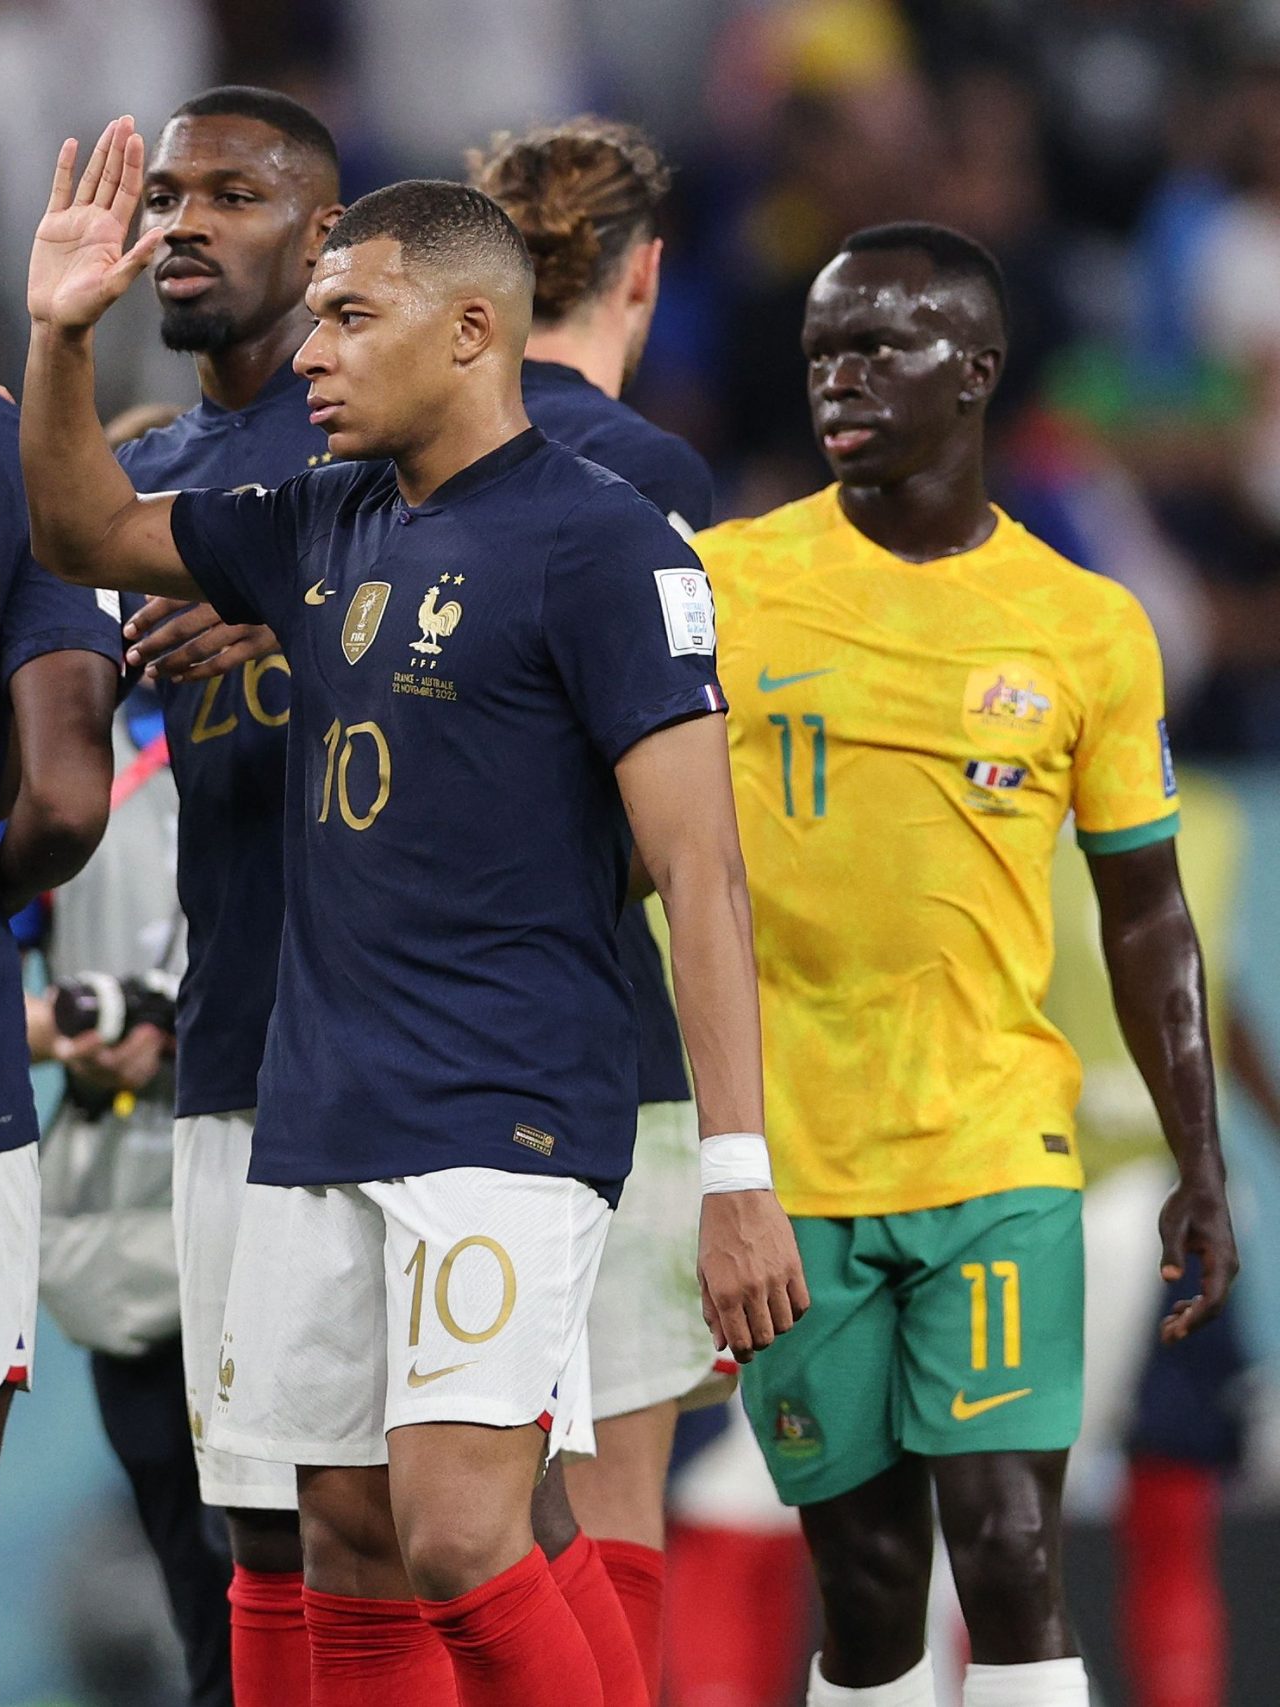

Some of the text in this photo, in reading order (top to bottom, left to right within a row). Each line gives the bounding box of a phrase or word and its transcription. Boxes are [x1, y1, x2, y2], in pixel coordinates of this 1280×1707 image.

[350, 632, 367, 642] FIFA
[393, 672, 415, 684] FRANCE
[421, 676, 454, 690] AUSTRALIE
[392, 682, 401, 693] 22
[435, 688, 457, 701] 2022
[318, 717, 391, 831] 10
[768, 713, 827, 818] 11
[403, 1234, 518, 1347] 10
[960, 1260, 1021, 1371] 11
